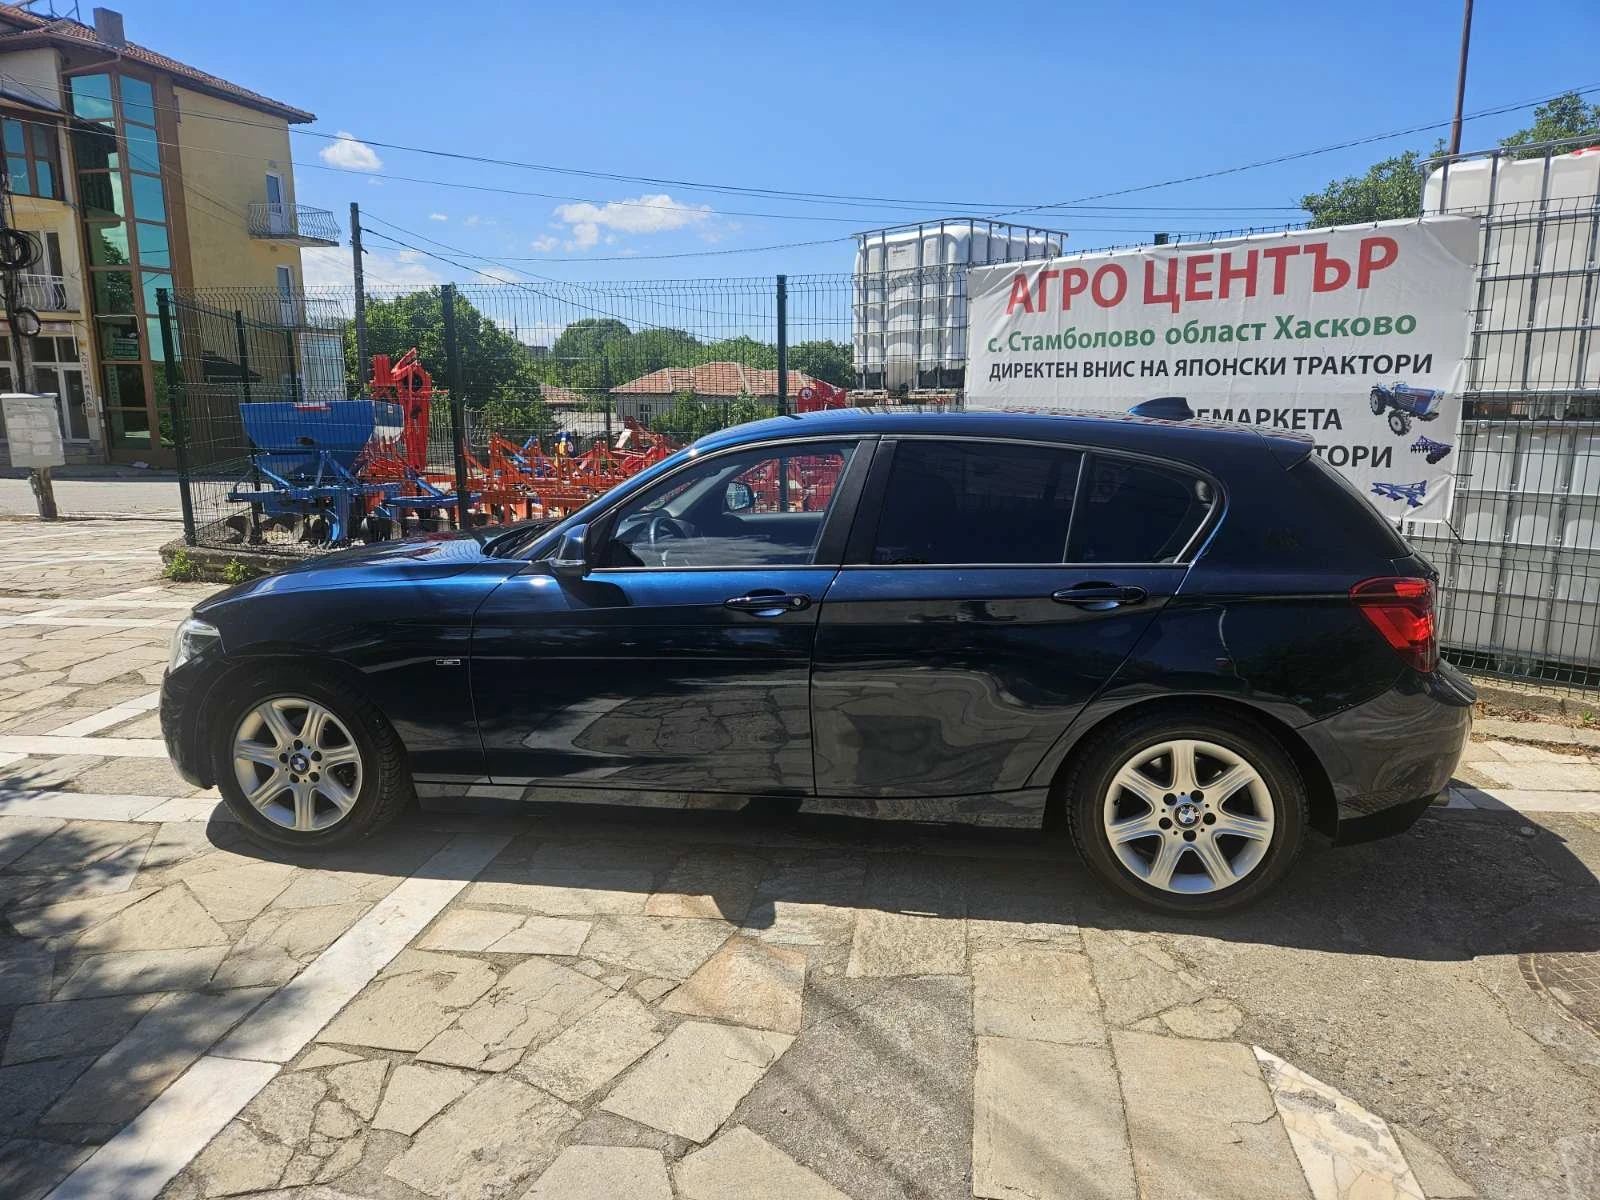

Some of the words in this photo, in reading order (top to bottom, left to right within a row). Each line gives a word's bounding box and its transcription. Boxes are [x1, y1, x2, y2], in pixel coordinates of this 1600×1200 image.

[1006, 263, 1128, 315] АГРО
[1143, 236, 1399, 314] ЦЕНТЪР
[987, 337, 1001, 353] с.
[1008, 326, 1156, 352] Стамболово
[1165, 319, 1267, 345] област
[1273, 314, 1417, 340] Хасково
[989, 361, 1078, 382] ДИРЕКТЕН
[1083, 360, 1135, 378] ВНИС
[1140, 359, 1169, 377] НА
[1174, 357, 1287, 377] ЯПОНСКИ
[1293, 353, 1433, 376] ТРАКТОРИ
